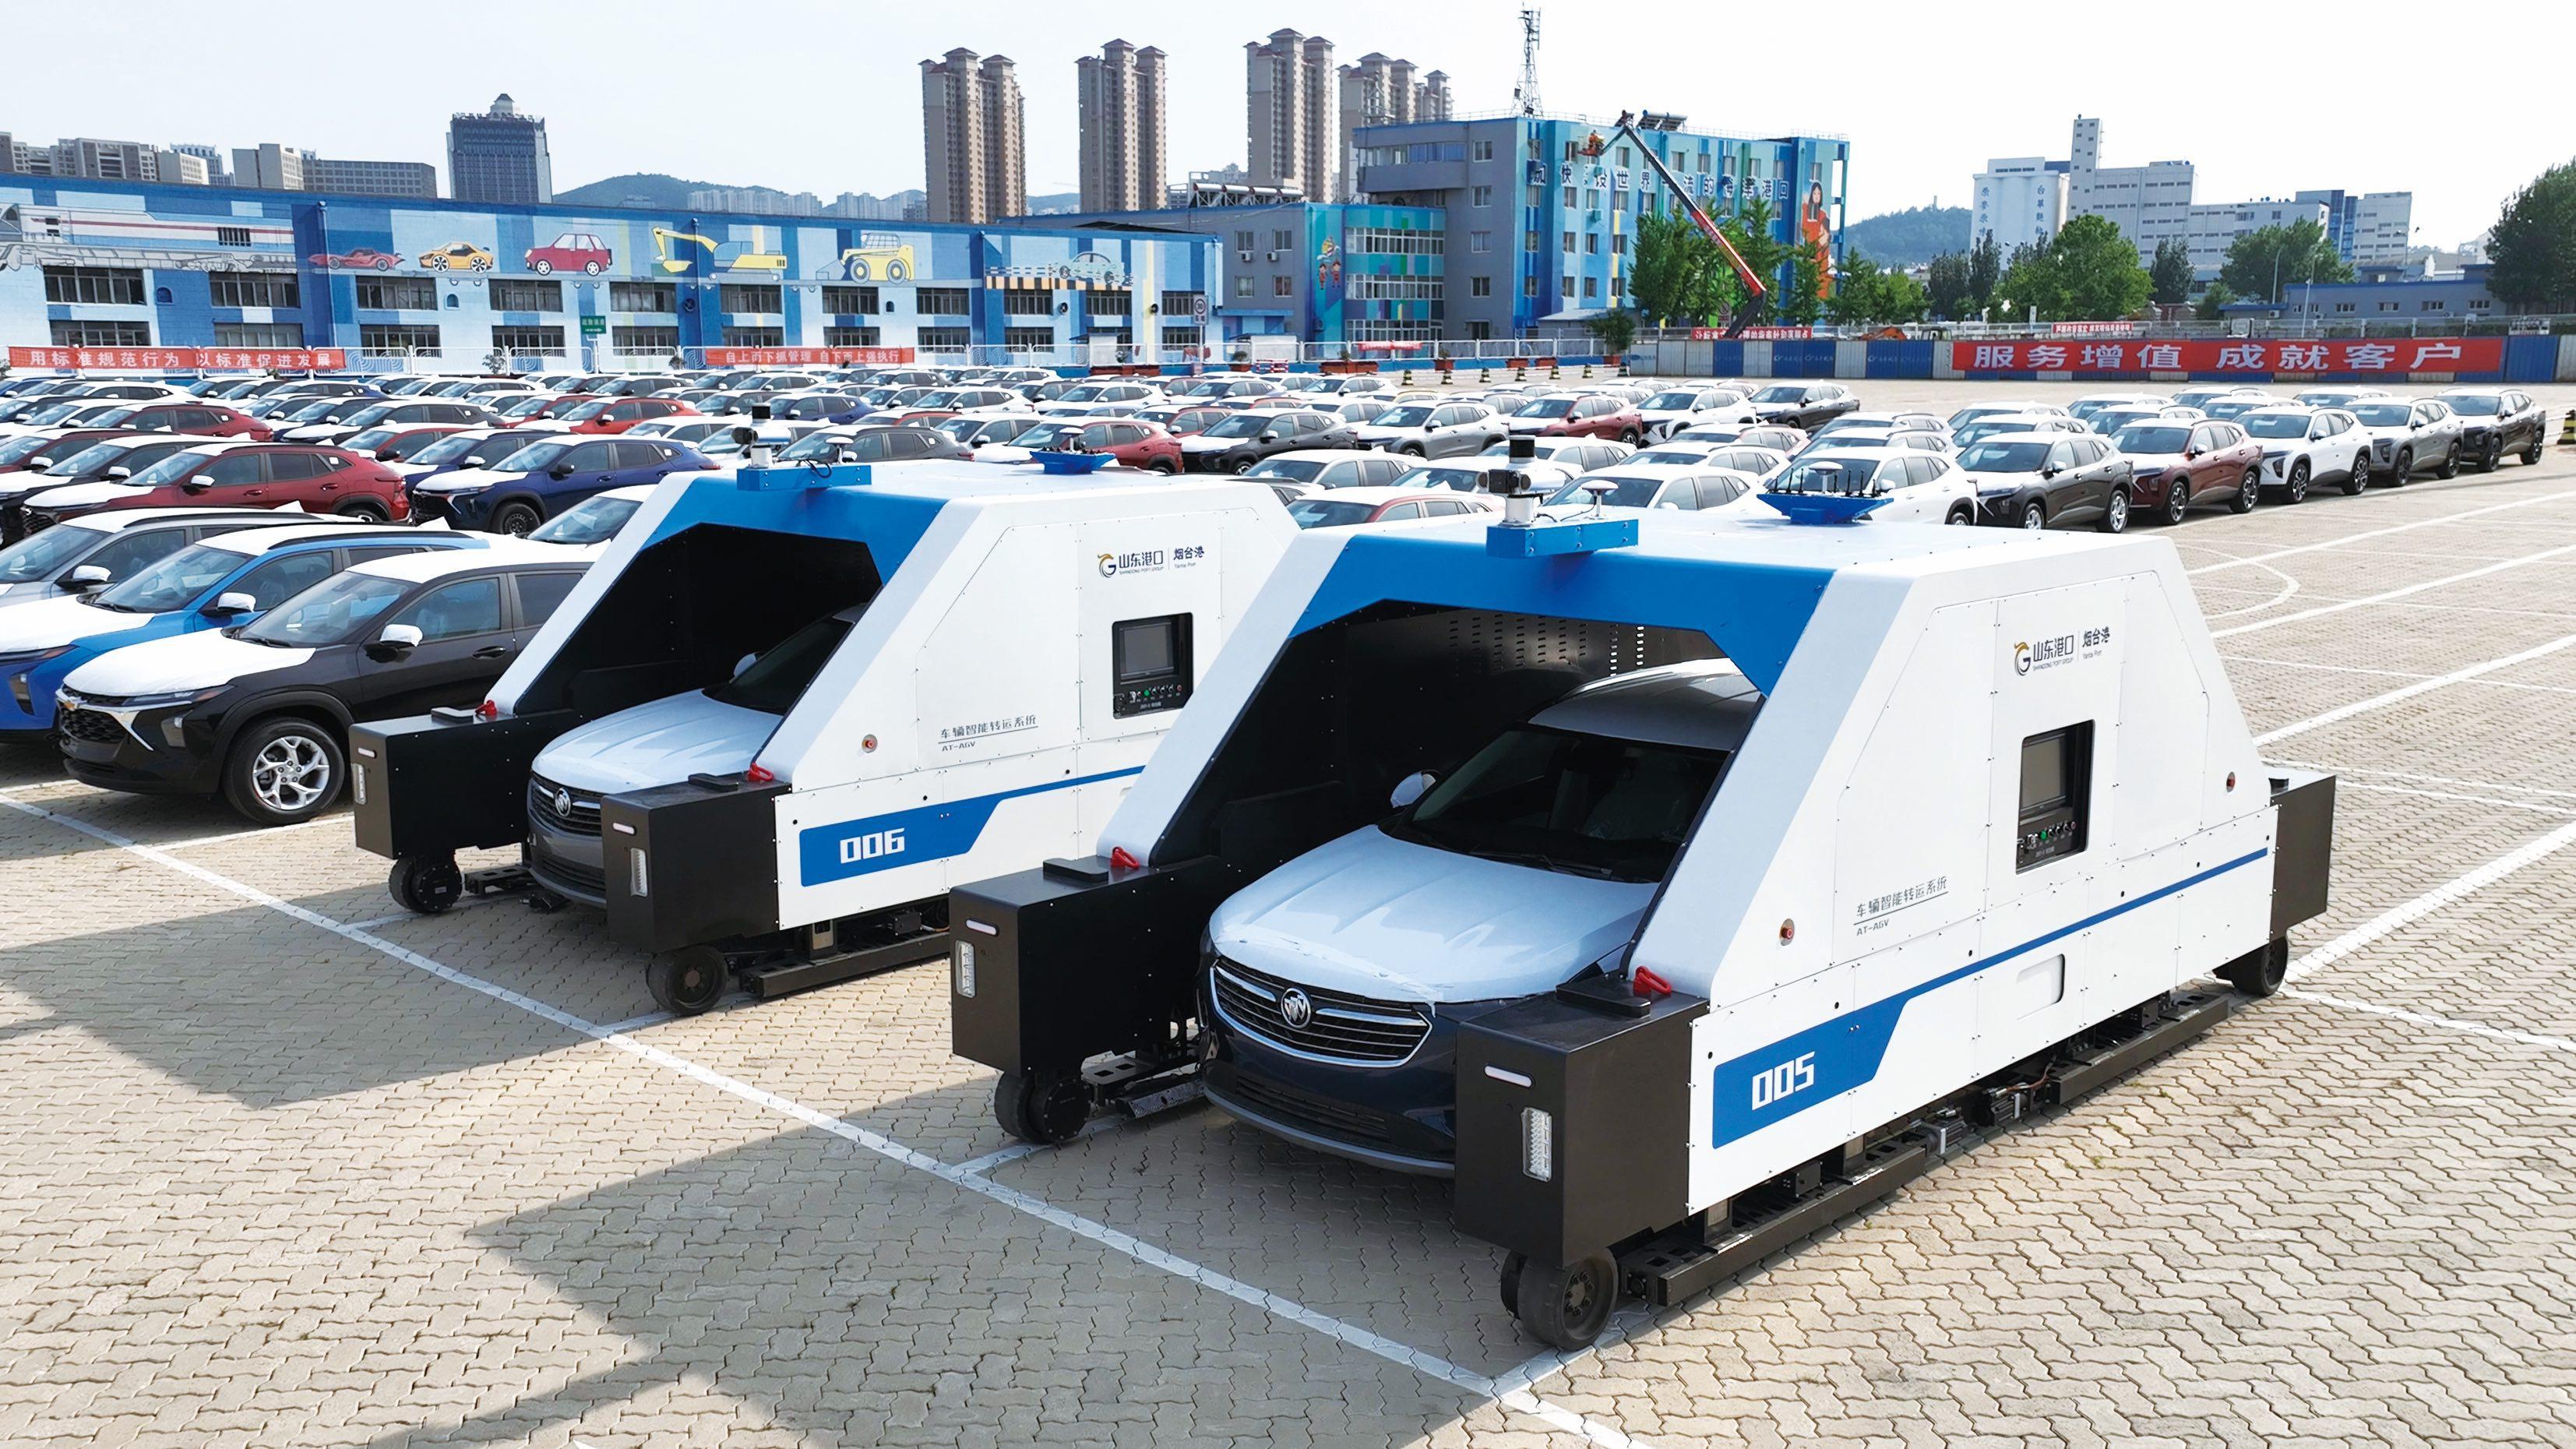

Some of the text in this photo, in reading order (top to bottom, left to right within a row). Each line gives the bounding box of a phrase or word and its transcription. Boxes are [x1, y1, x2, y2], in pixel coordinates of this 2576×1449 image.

[30, 351, 331, 368] 用标准规范行为 以标准促进发展
[726, 351, 899, 363] 自上而下抓管理 自下而上强执行
[1974, 343, 2461, 370] 服务增值 成就客户
[1119, 545, 1205, 569] 山东港口 烟台港
[2033, 626, 2110, 662] 山东港口 烟台港
[941, 714, 1036, 739] 车辆智能转运系统
[942, 741, 975, 752] AT-AGV
[840, 827, 905, 864] 006
[1857, 876, 1947, 918] 车辆智能转运系统
[1857, 918, 1889, 936] AT-AGV
[1752, 1051, 1815, 1111] 005
